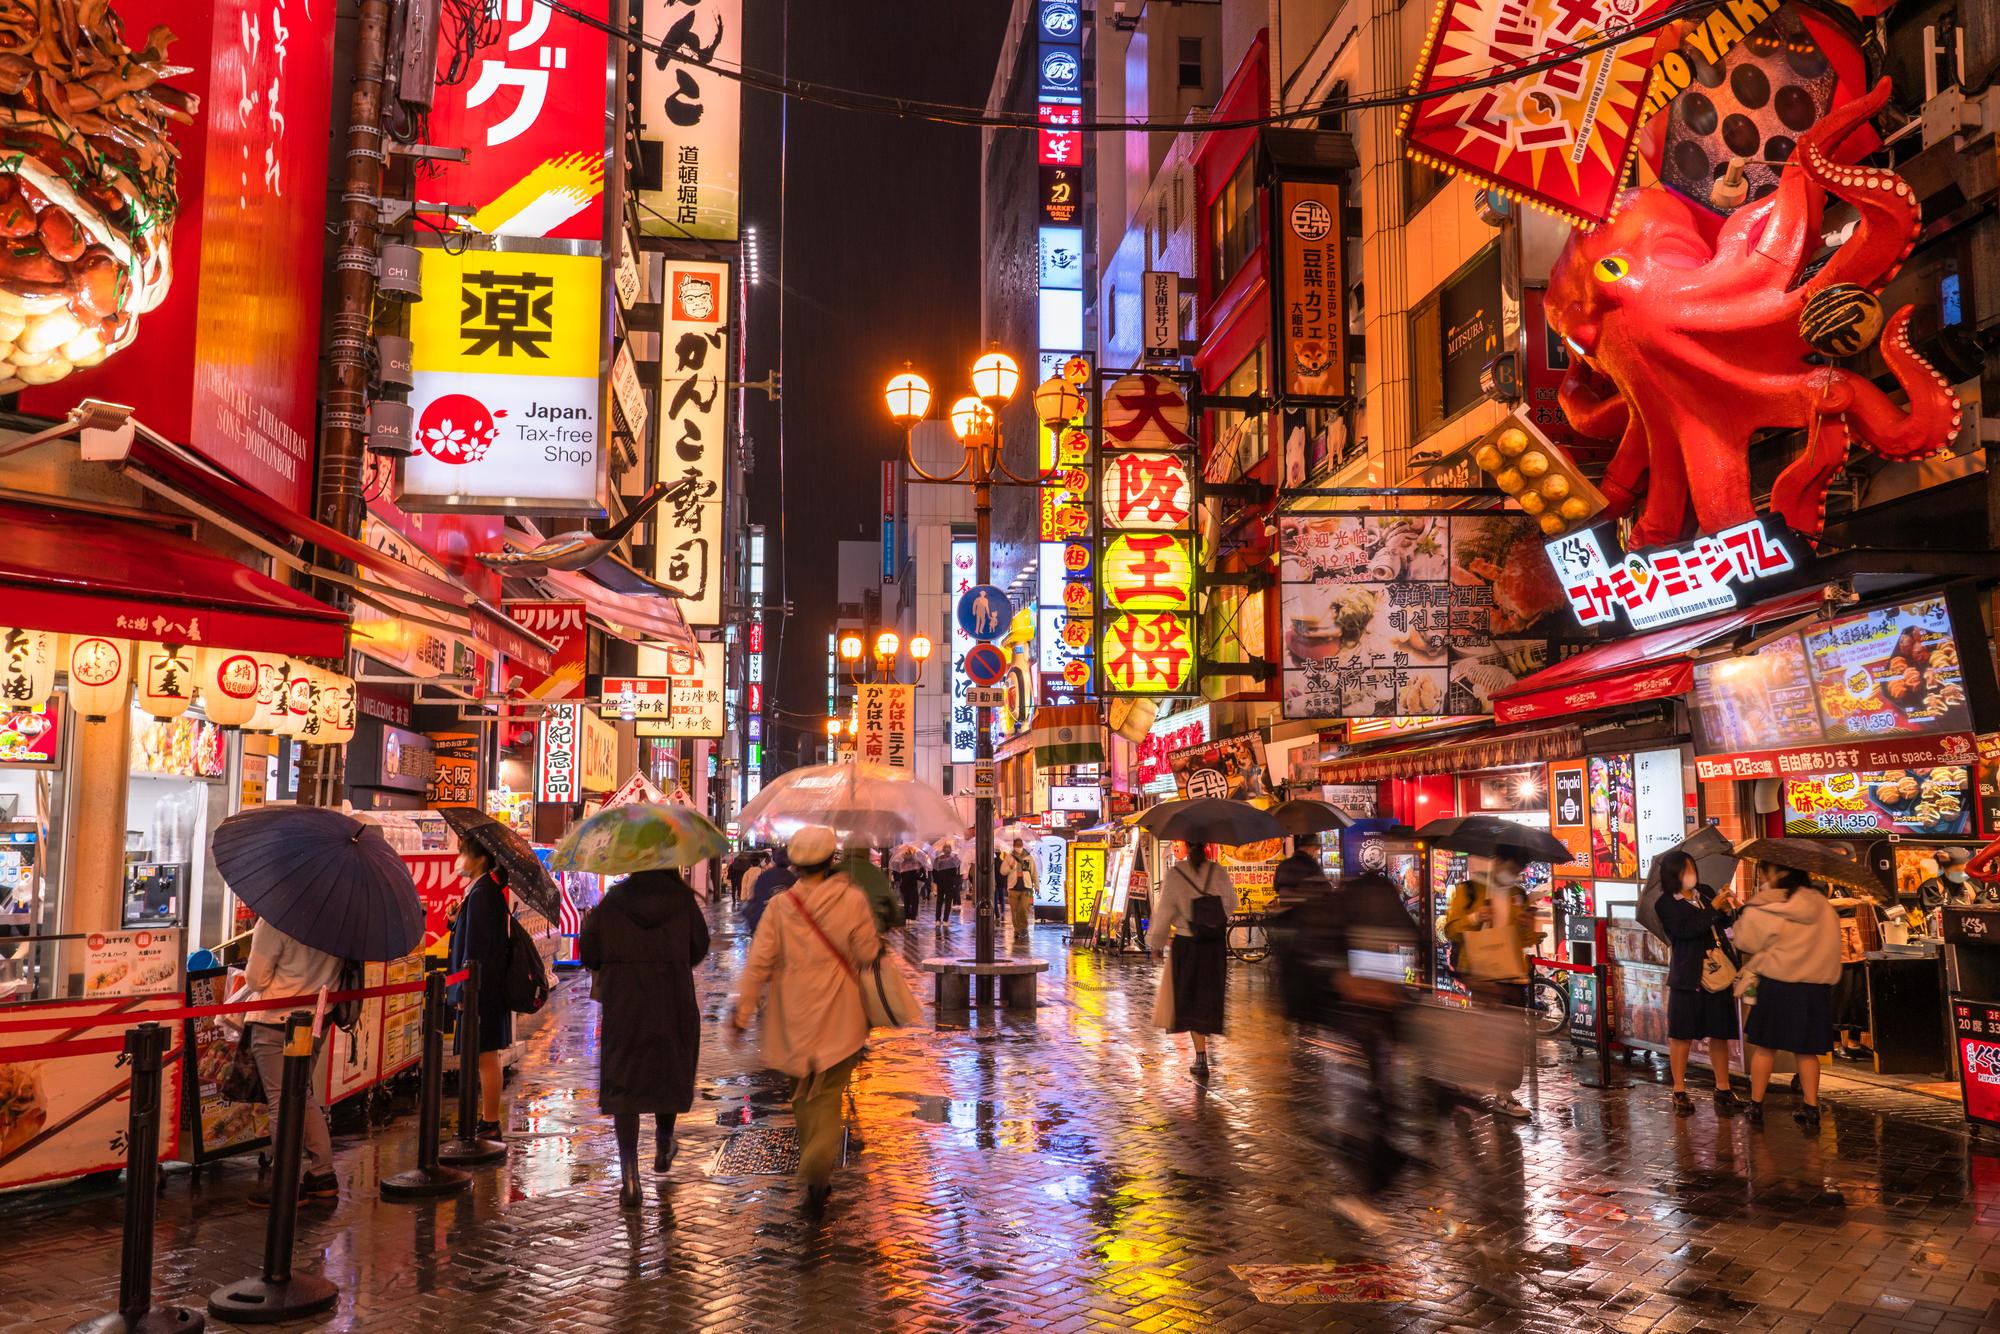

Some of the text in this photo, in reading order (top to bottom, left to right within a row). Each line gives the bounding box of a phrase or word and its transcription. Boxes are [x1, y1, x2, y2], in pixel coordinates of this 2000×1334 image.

[655, 0, 722, 126] んこ
[677, 146, 699, 225] 道頓堀店
[388, 267, 409, 277] CH1
[1302, 248, 1323, 339] 豆柴カフェ
[1326, 243, 1337, 358] MAMESHIBA CAFE
[460, 270, 553, 359] 薬
[1291, 302, 1304, 338] 大阪店
[1447, 320, 1485, 356] MITSUBA
[390, 359, 410, 371] CH3
[1041, 355, 1052, 363] 4F
[525, 402, 593, 423] Japan.
[377, 424, 399, 435] CH4
[515, 424, 593, 443] Tax-free
[544, 445, 592, 466] Shop
[1102, 373, 1198, 690] 大阪王将
[1293, 529, 1369, 552] 欢迎光临
[1299, 552, 1370, 573] 어서오세요
[513, 609, 583, 631] ツルハ
[752, 656, 760, 681] NYNY
[621, 680, 648, 693] 地階
[967, 691, 1003, 703] 自動車
[363, 697, 394, 721] WELCOME
[888, 687, 905, 768] がんばれミナミ
[1170, 745, 1212, 760] MAMESHIBA
[1213, 740, 1233, 750] CAFE
[1700, 763, 1712, 776] 1F
[1737, 760, 1751, 774] 2F
[1778, 749, 1860, 771] 自由席あります
[1871, 752, 1888, 766] Eat
[1890, 751, 1900, 764] in
[1902, 750, 1936, 766] space.
[435, 765, 471, 784] 大阪
[1824, 815, 1877, 829] ¥1,350
[1959, 1007, 1968, 1016] 1F
